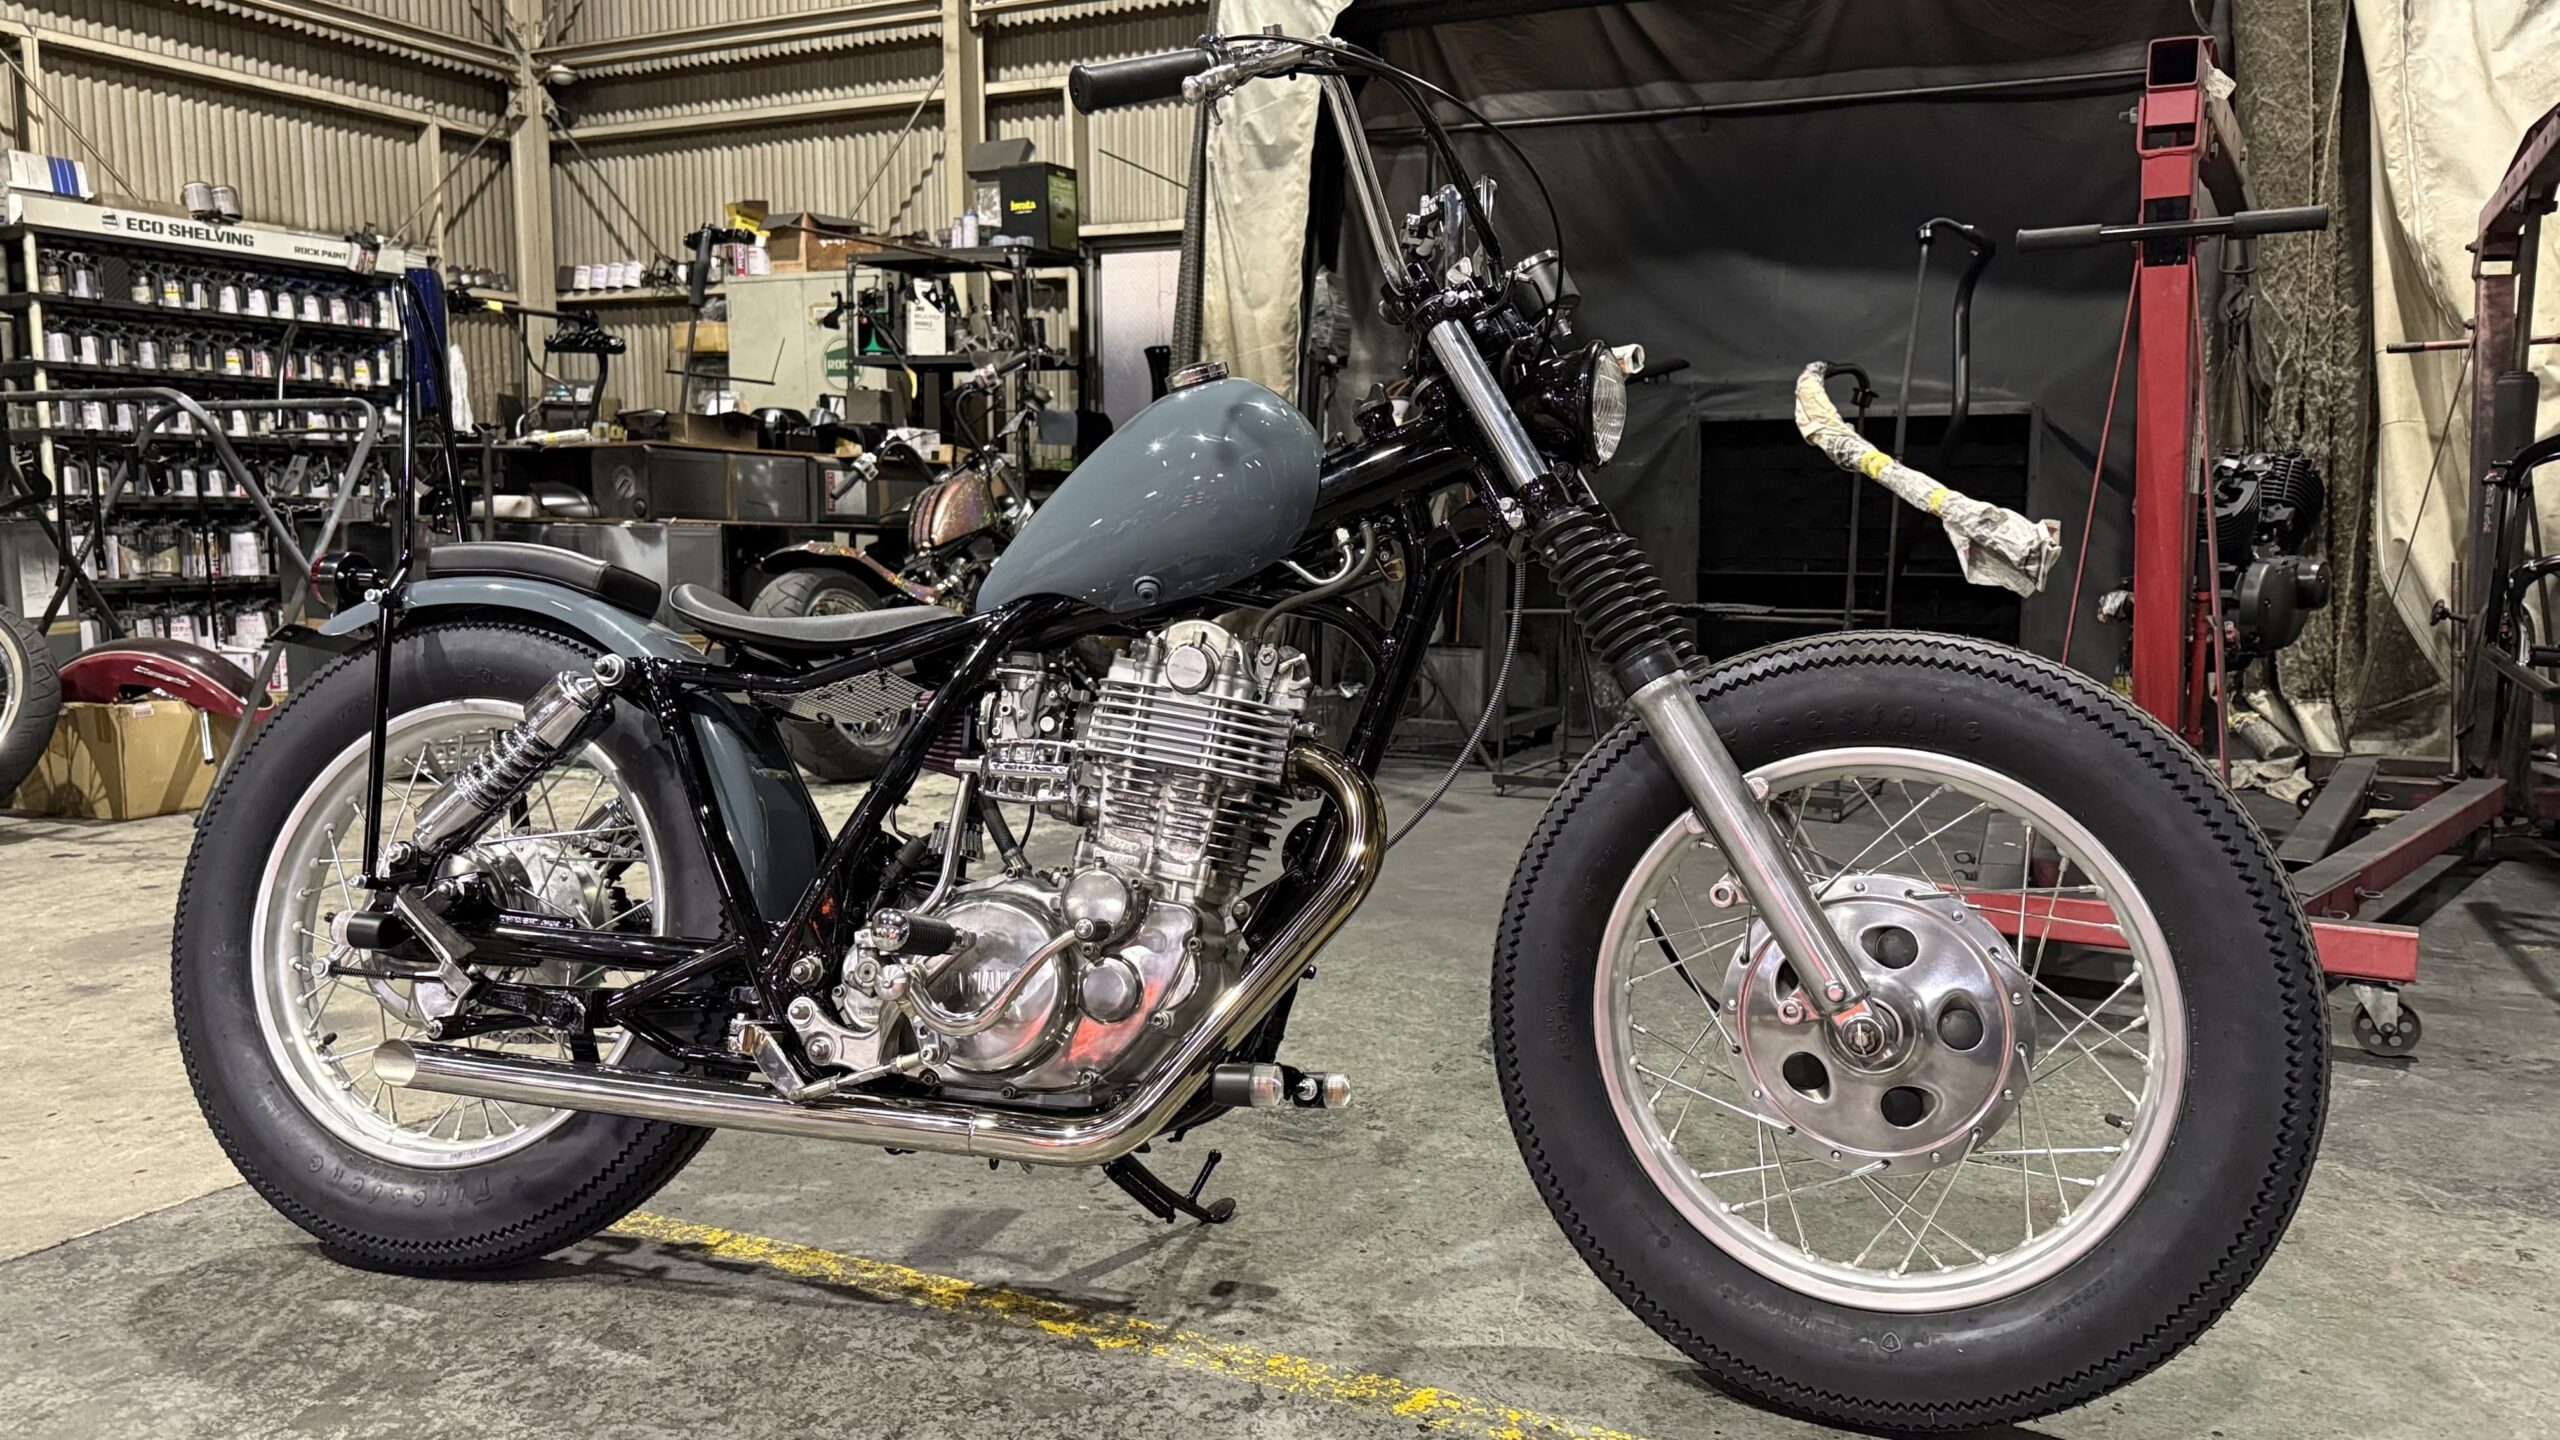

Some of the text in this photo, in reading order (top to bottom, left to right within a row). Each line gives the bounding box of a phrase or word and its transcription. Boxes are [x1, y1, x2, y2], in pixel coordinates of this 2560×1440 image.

[126, 217, 254, 247] ECO SHELVING
[294, 246, 347, 261] ROCK PAINT
[827, 360, 849, 370] ROC
